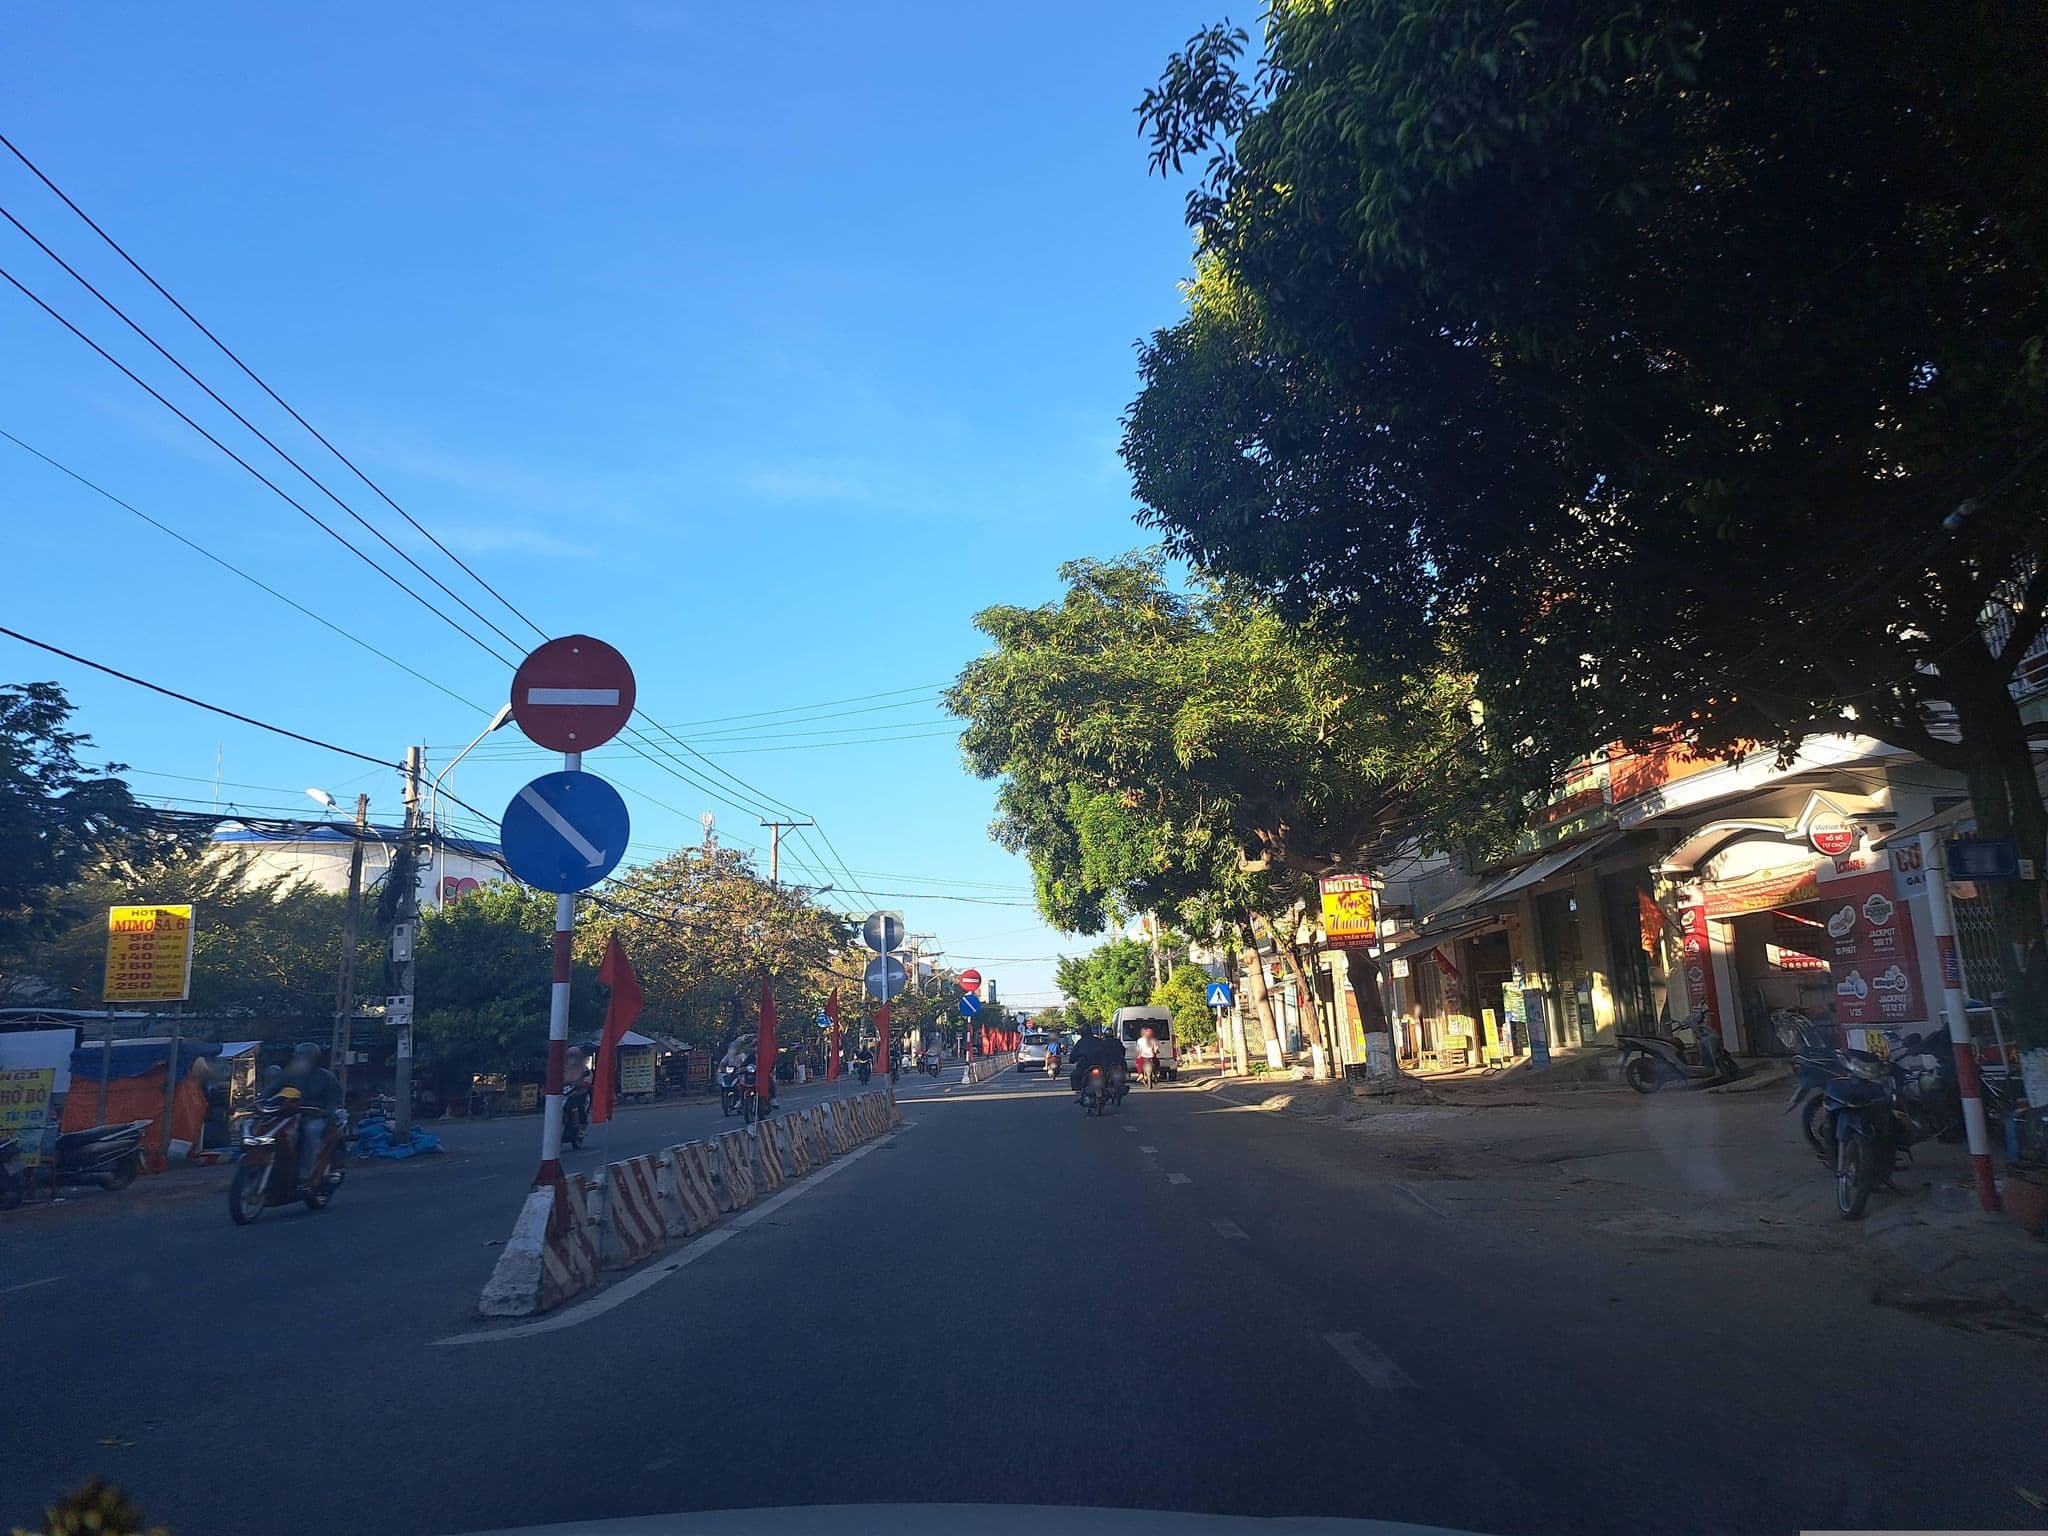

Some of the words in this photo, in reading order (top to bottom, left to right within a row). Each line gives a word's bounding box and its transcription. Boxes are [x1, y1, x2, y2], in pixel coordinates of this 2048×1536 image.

[1325, 879, 1367, 893] HOTEL
[115, 919, 171, 931] MIMOSA
[176, 919, 185, 930] 6
[1868, 928, 1895, 938] JACKPOT
[1879, 994, 1906, 1003] JACKPOT
